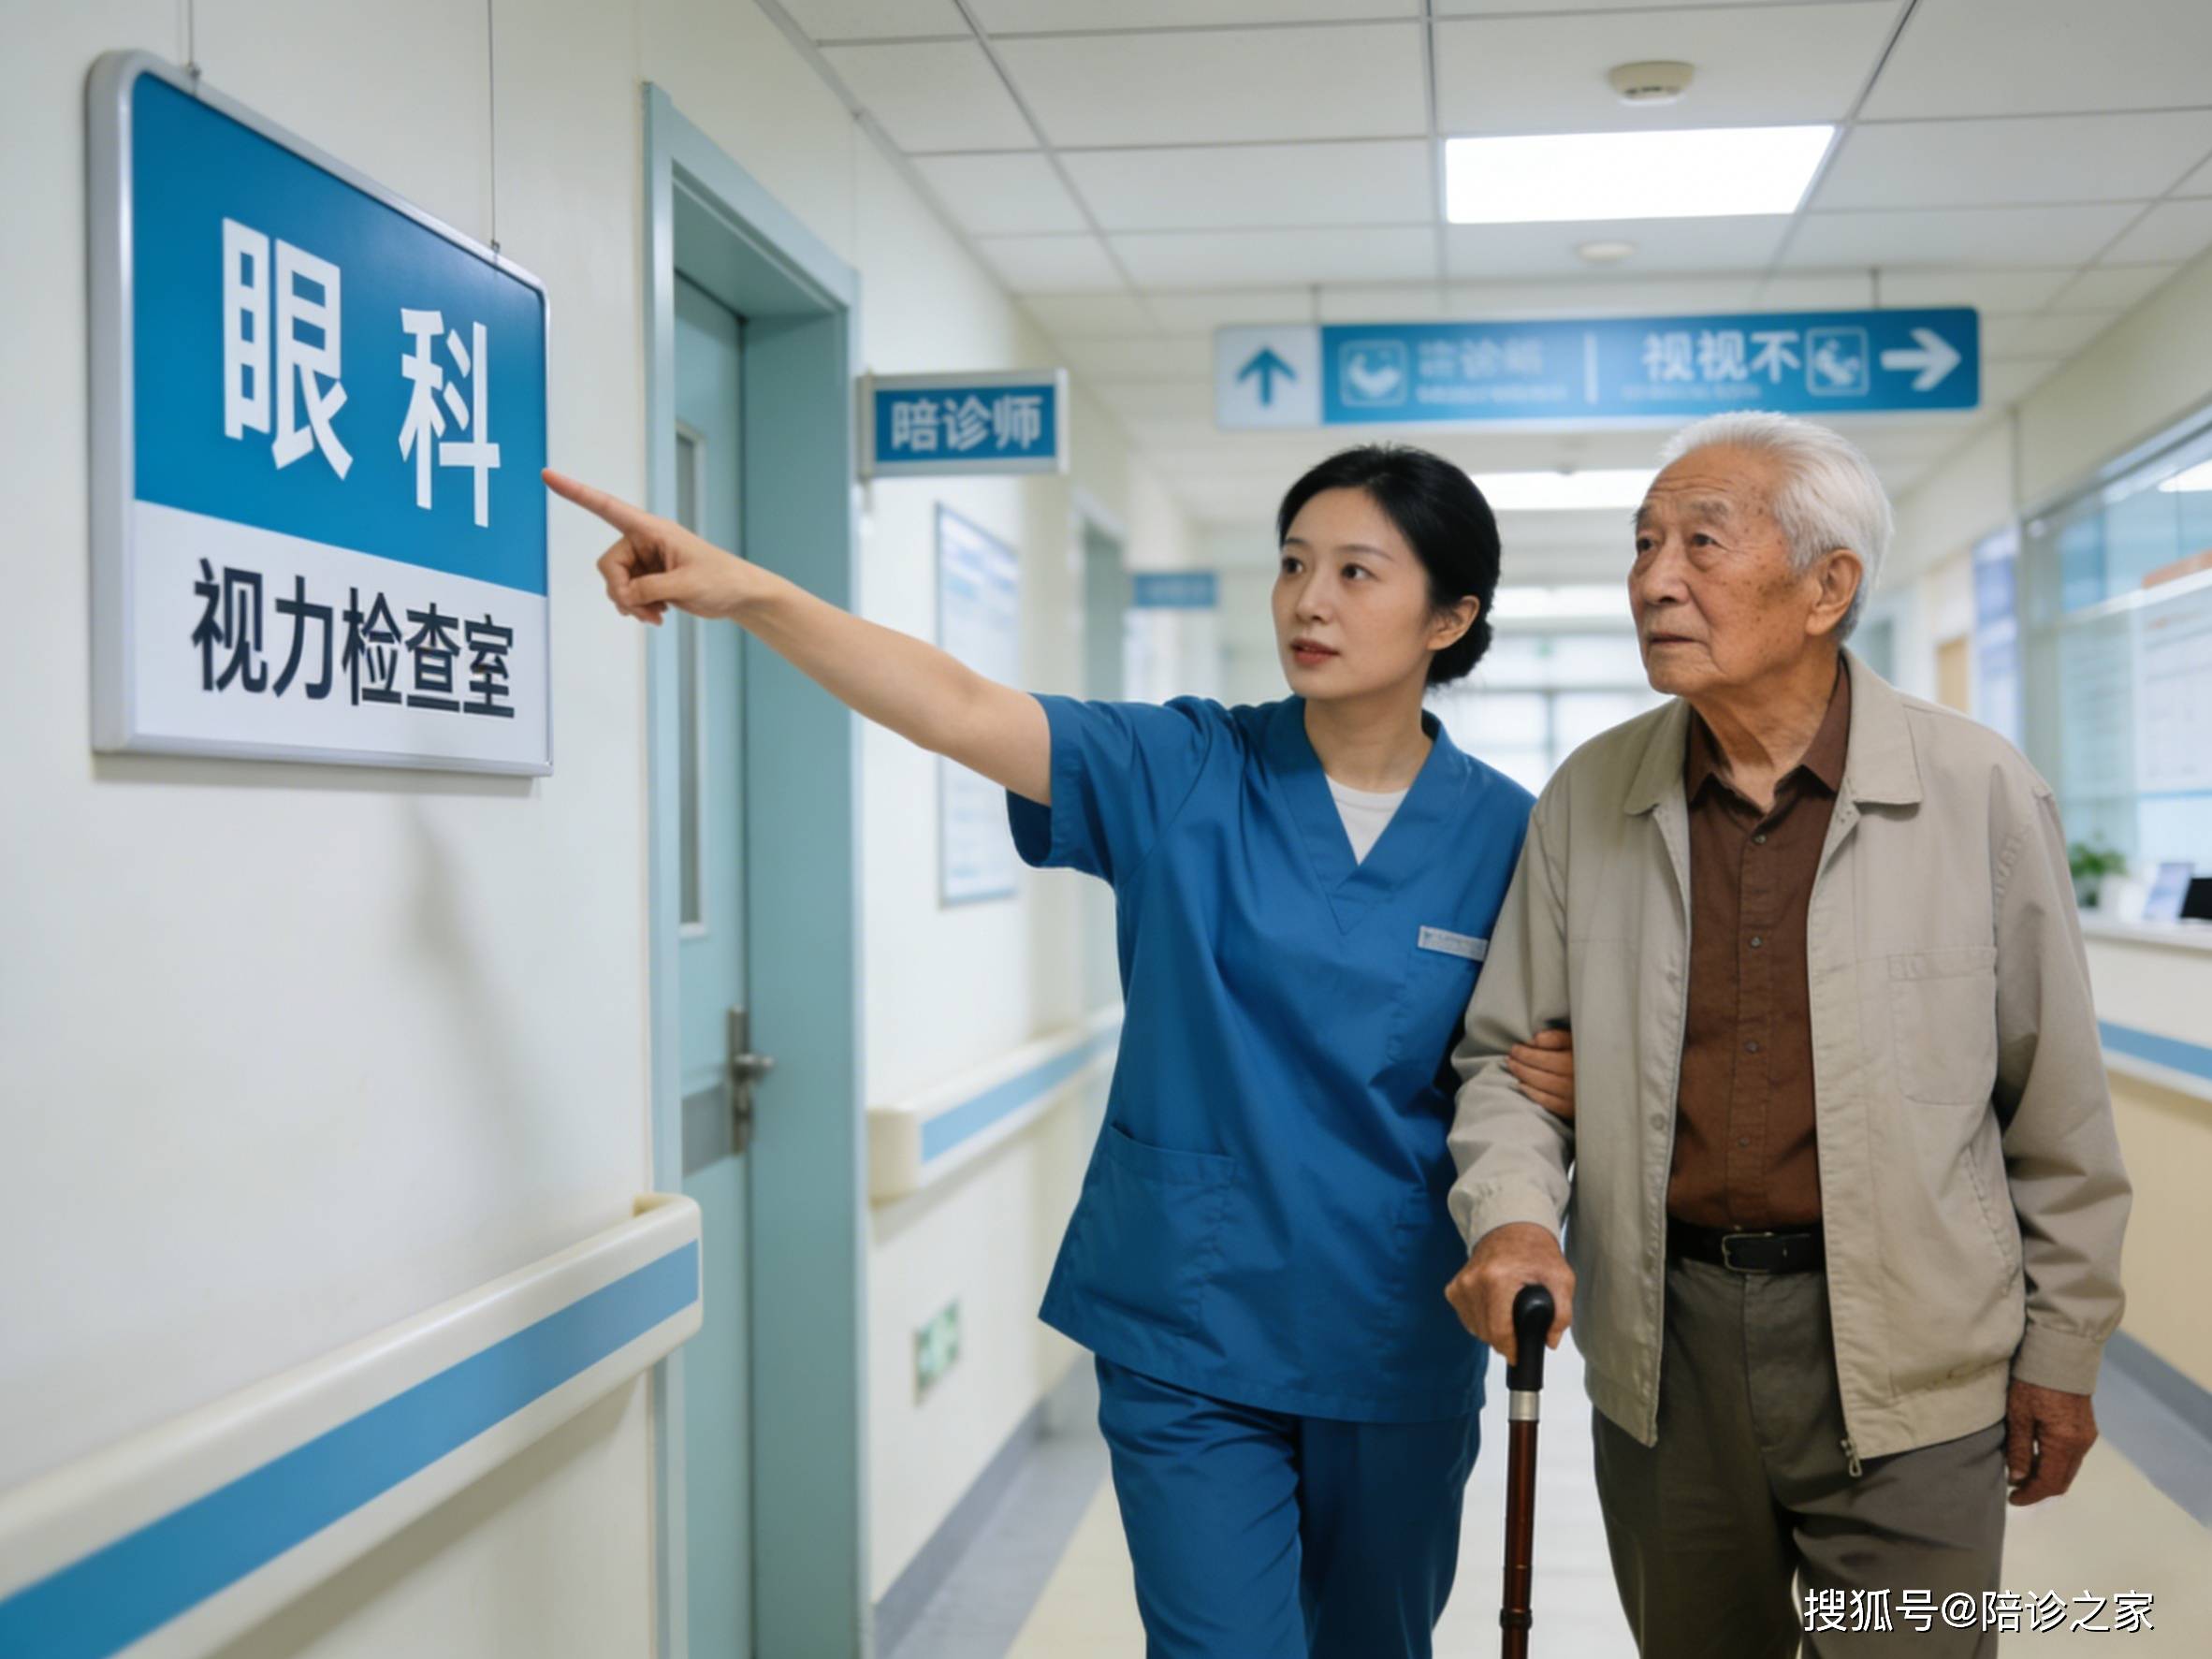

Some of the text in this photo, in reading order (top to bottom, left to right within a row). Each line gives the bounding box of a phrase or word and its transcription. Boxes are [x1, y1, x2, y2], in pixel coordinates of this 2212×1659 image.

[221, 216, 502, 529] 眼科
[892, 394, 1043, 452] 陪诊师
[191, 558, 515, 719] 视力检查室
